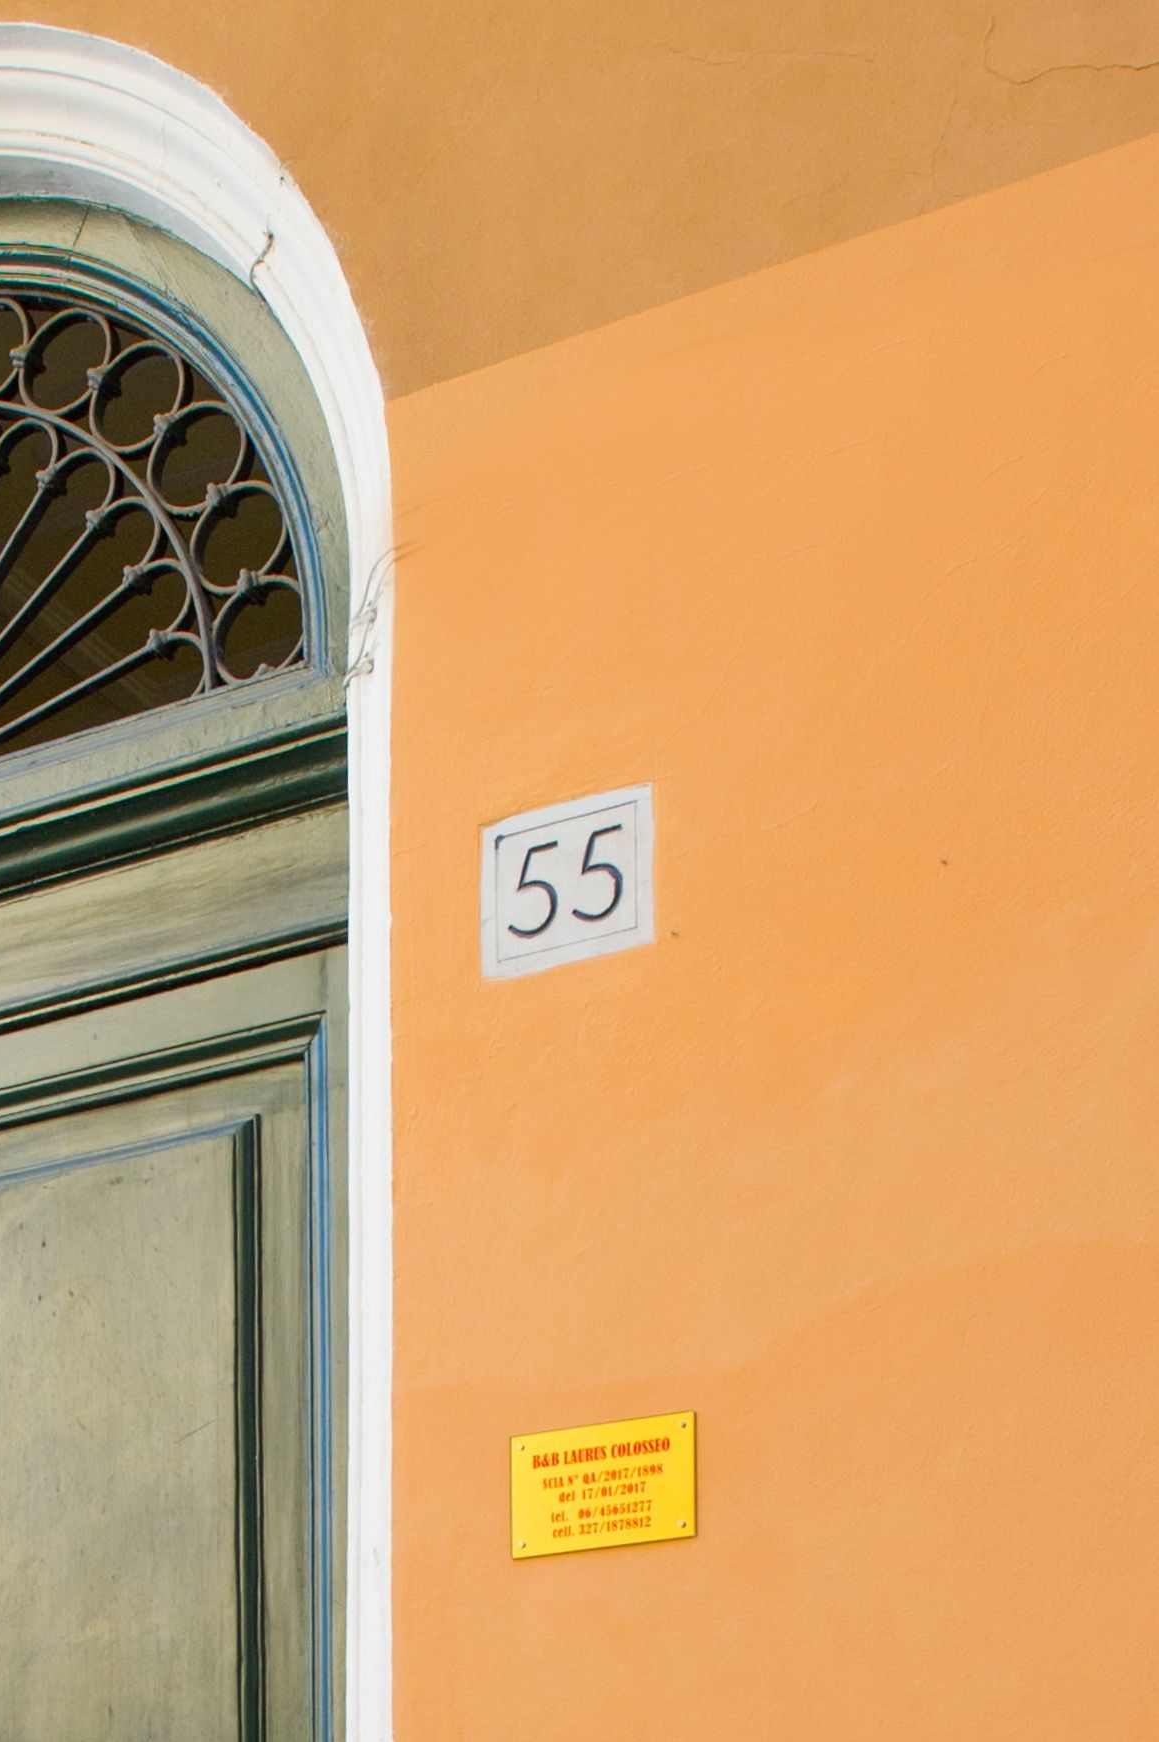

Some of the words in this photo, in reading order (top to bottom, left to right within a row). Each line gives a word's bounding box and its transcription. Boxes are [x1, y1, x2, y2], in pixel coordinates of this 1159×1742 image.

[508, 824, 623, 939] 55
[532, 1453, 559, 1469] B&B
[564, 1446, 607, 1465] LAURUS
[611, 1437, 670, 1457] COLOSSEO
[542, 1477, 564, 1489] SCIA
[558, 1490, 575, 1503] del
[581, 1481, 646, 1501] 17/01/2017
[551, 1511, 569, 1523] tel.
[552, 1526, 575, 1538] cell.
